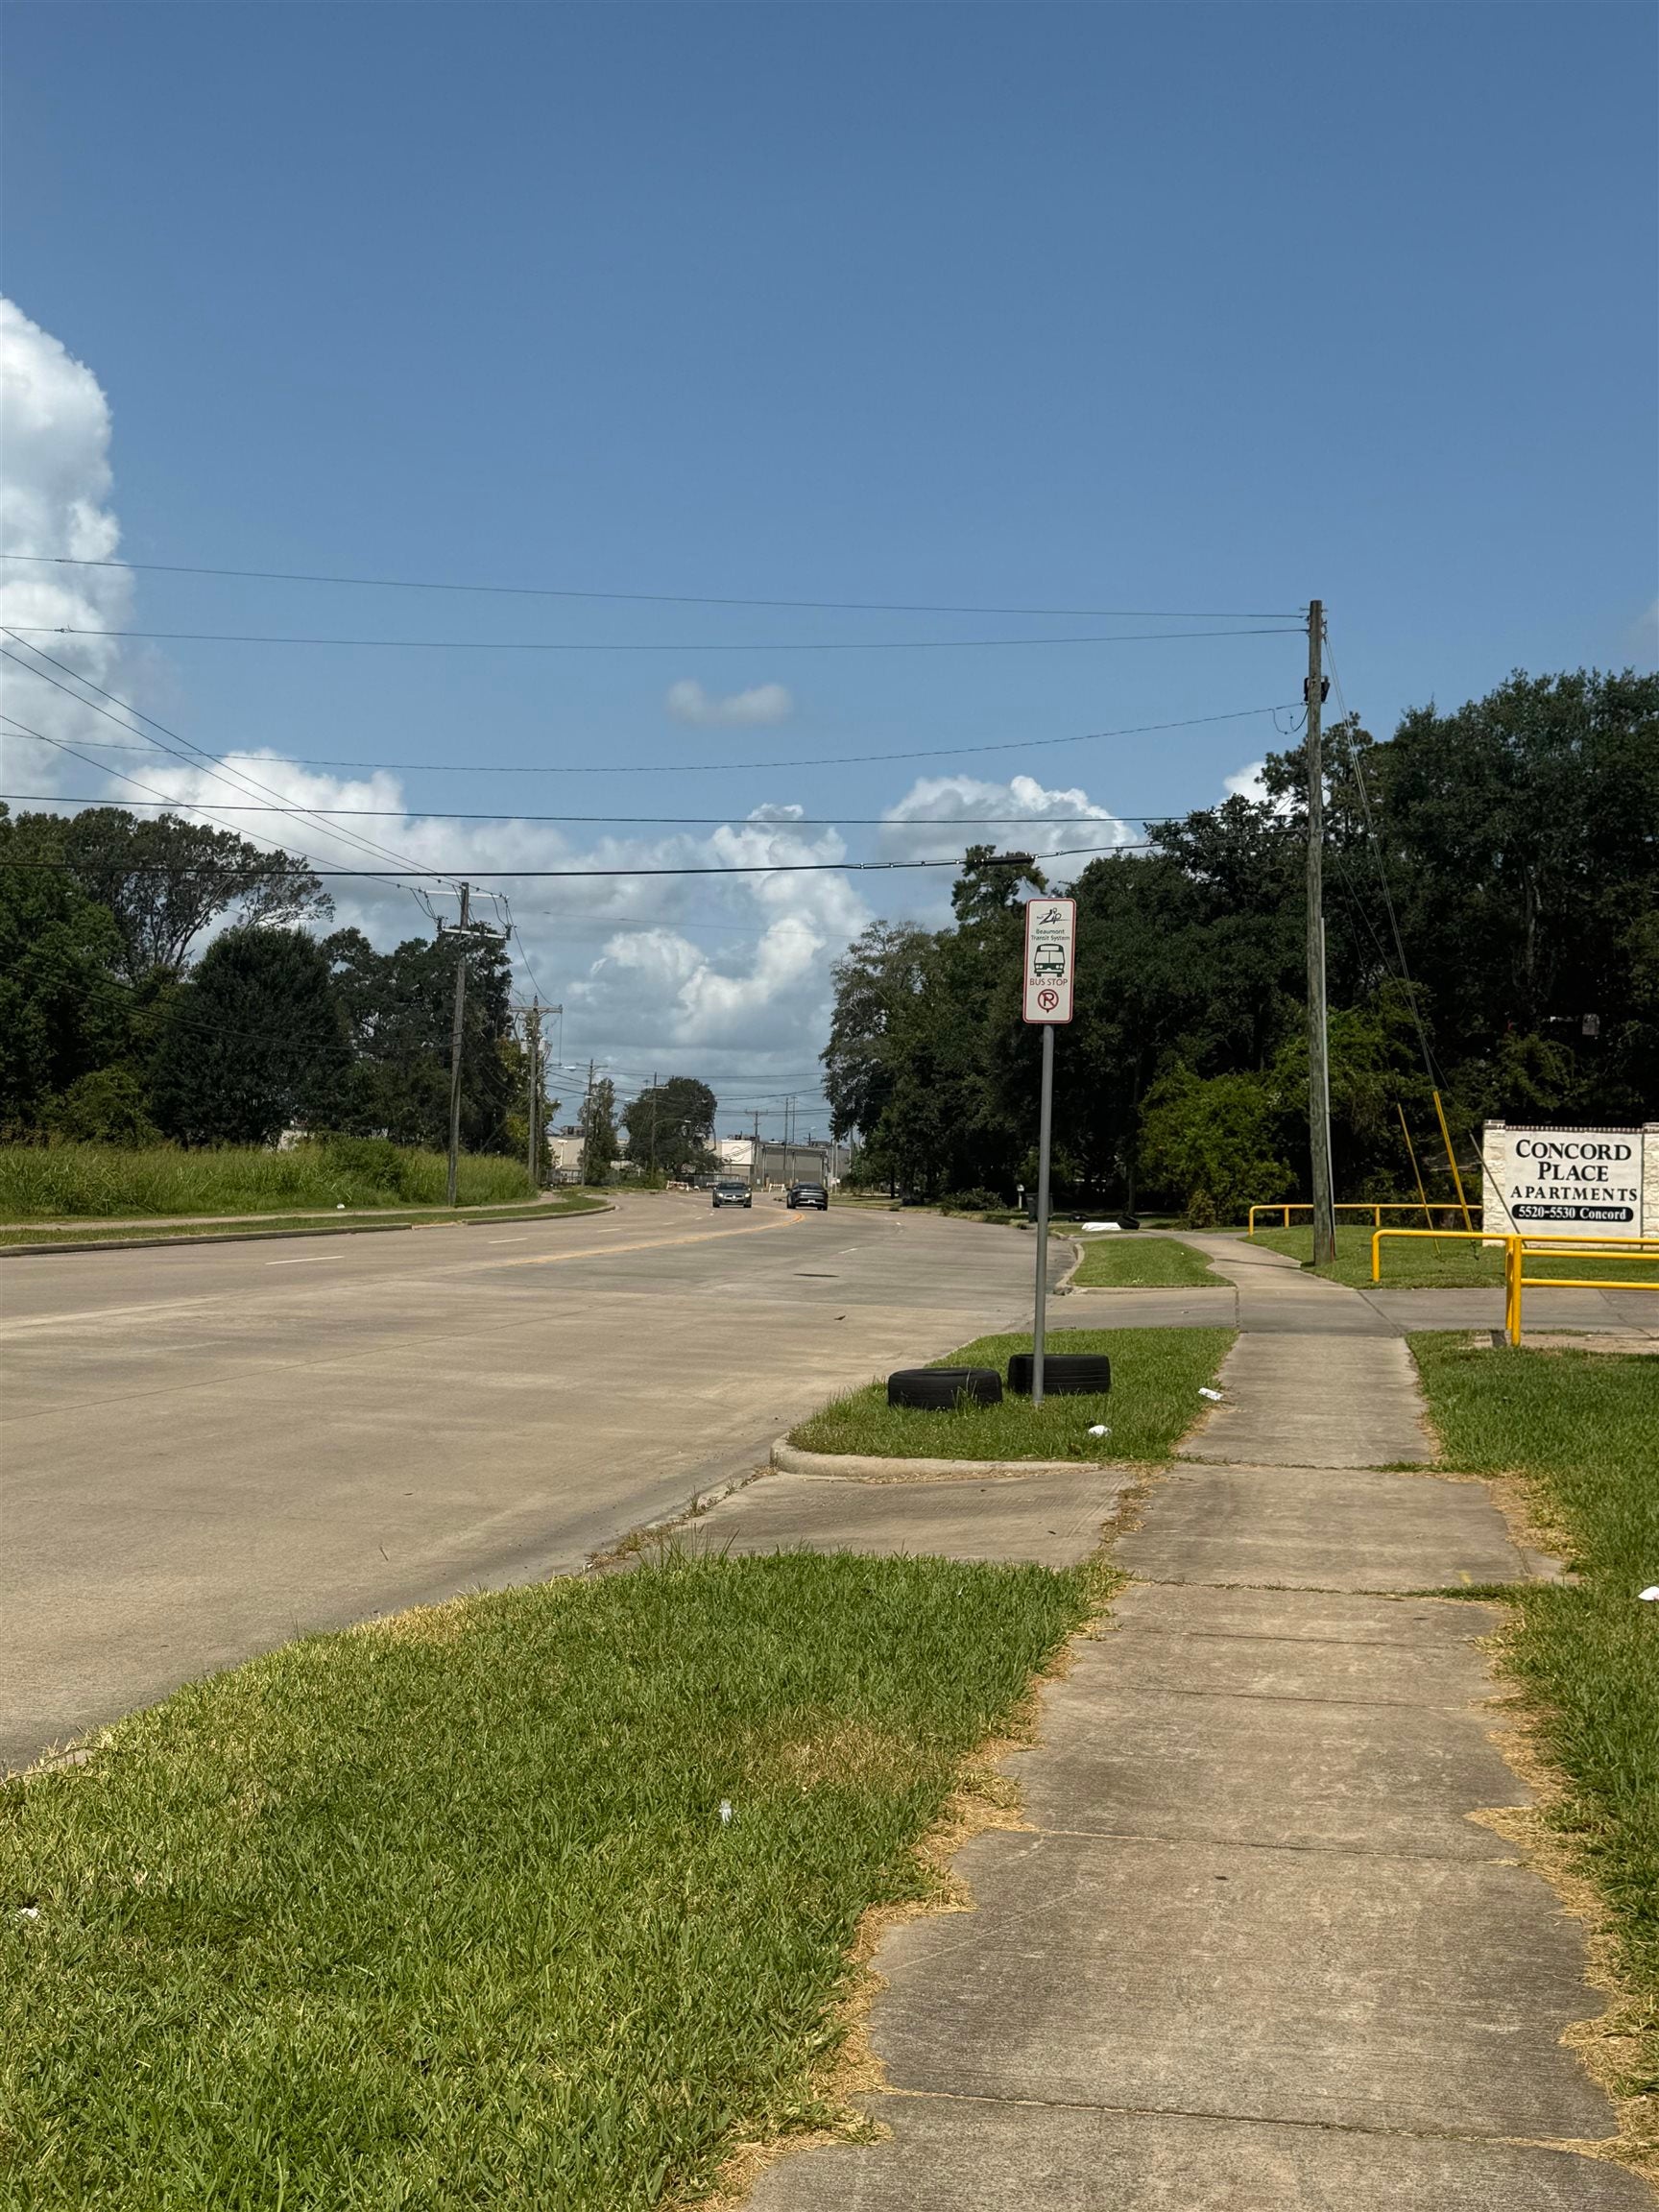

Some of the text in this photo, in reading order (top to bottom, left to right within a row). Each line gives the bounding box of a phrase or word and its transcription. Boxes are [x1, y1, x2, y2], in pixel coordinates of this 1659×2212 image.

[1029, 977, 1046, 986] BUS
[1516, 1139, 1632, 1161] CONCORD
[1537, 1161, 1609, 1182] PLACE
[1510, 1185, 1638, 1202] APARTMENTS
[1518, 1205, 1627, 1220] 5520-5530 Concord
